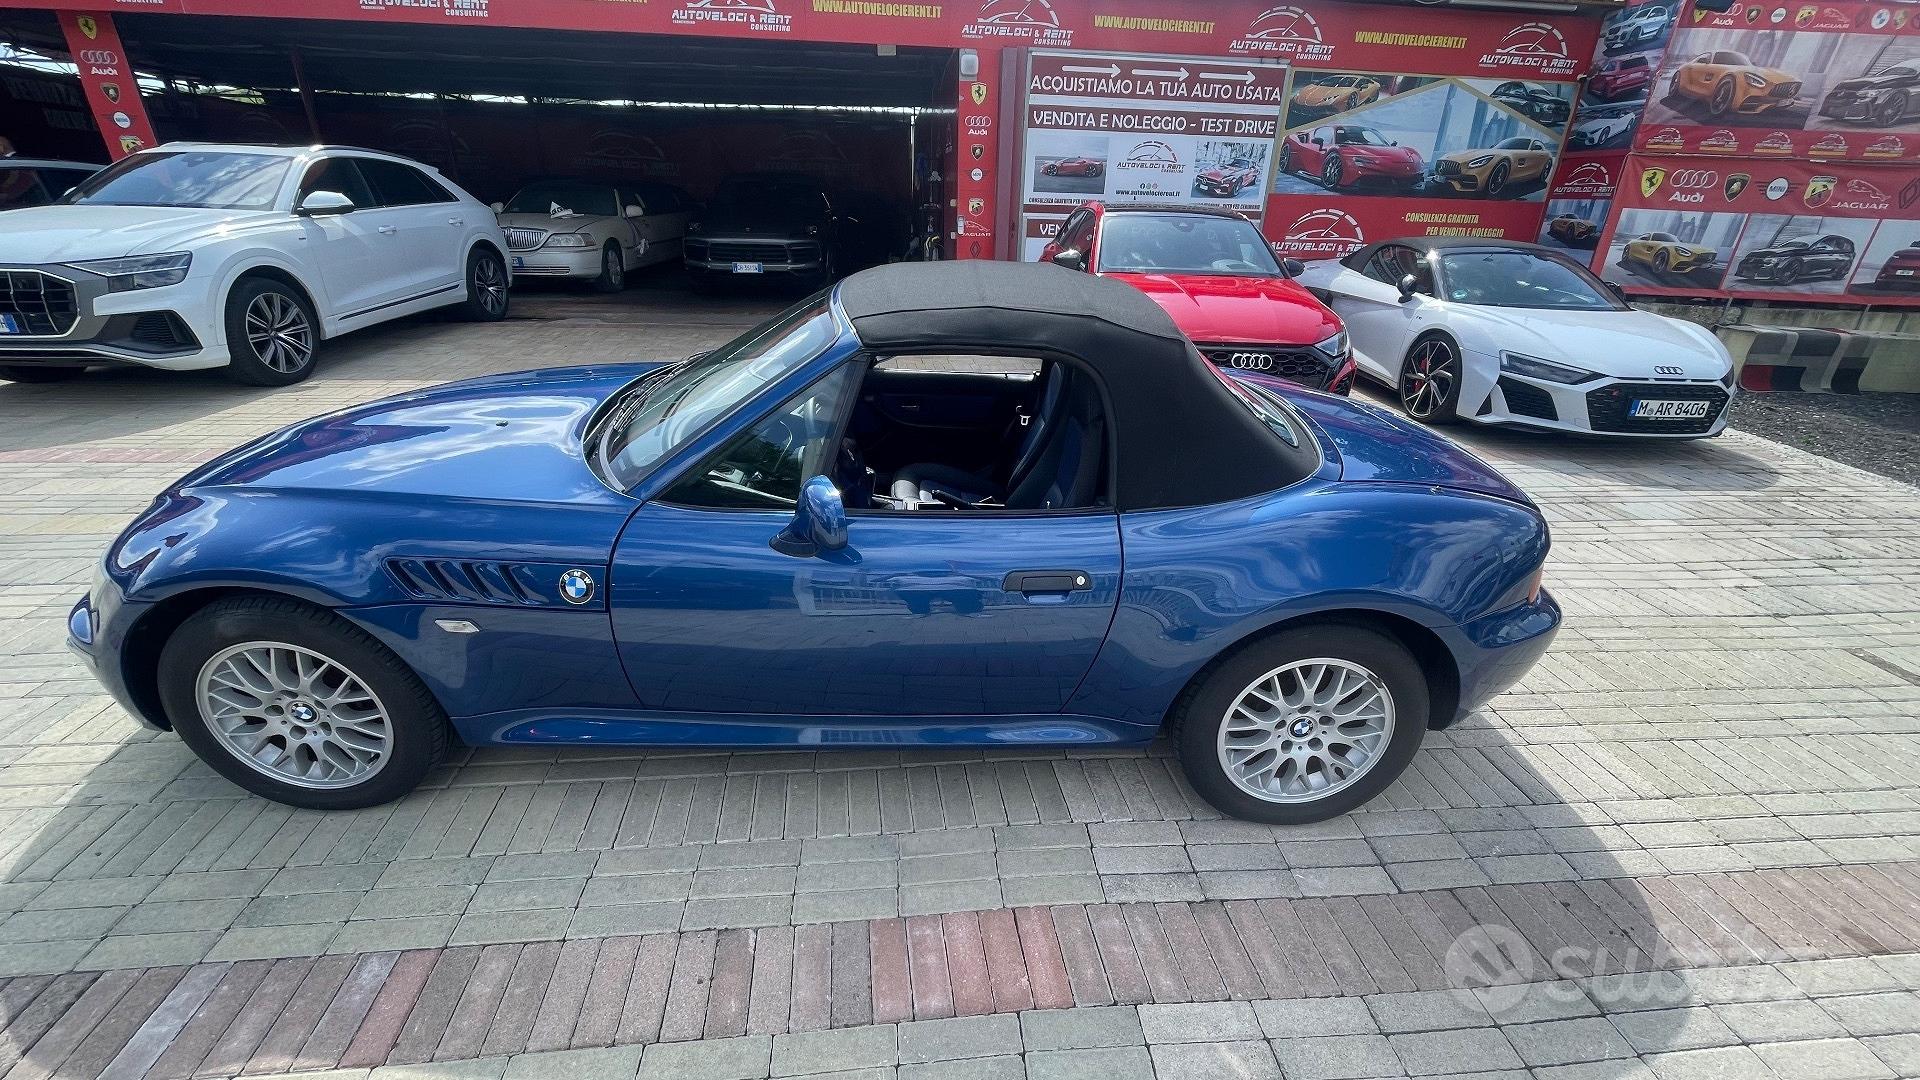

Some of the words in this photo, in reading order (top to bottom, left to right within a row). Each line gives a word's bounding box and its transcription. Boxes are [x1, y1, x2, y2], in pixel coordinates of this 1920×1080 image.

[445, 9, 488, 17] CONSULTING
[812, 0, 942, 18] WWW.AUTOVELOCIERENT.IT
[671, 9, 747, 22] AUTOVELOCI
[749, 15, 756, 23] &
[759, 14, 792, 25] RENT
[1711, 17, 1734, 25] Audi
[750, 23, 791, 32] CONSULTING
[1094, 15, 1215, 34] WWW.AUTOVELOCIERENT.IT
[962, 24, 1032, 36] AUTOVELOCI
[1034, 29, 1040, 37] &
[1043, 28, 1074, 39] RENT
[1033, 38, 1071, 46] CONSULTING
[1229, 39, 1296, 52] AUTOVELOCI
[1297, 44, 1302, 52] &
[1305, 43, 1336, 54] RENT
[1354, 31, 1467, 49] WWW.AUTOVELOCIERENT.IT
[1296, 52, 1332, 60] CONSULTING
[1479, 54, 1542, 66] AUTOVELOCI
[1550, 58, 1577, 68] RENT
[91, 66, 118, 76] Audi
[1031, 75, 1132, 97] ACQUISTIAMO
[1136, 79, 1154, 98] LA
[1160, 80, 1187, 100] TUA
[1192, 82, 1231, 102] AUTO
[1236, 84, 1281, 104] USATA
[1033, 110, 1095, 127] VENDITA
[1101, 112, 1108, 128] E
[1112, 113, 1186, 134] NOLEGGIO
[1200, 117, 1230, 135] TEST
[1235, 119, 1275, 138] DRIVE
[968, 127, 988, 136] Audi
[1668, 191, 1705, 204] Audi
[1832, 202, 1889, 210] JAGUAR
[1405, 212, 1447, 223] CONSULENZA
[1447, 214, 1480, 224] GRATUITA
[1425, 226, 1439, 236] PER
[1439, 227, 1466, 237] VENDITA
[1466, 228, 1471, 236] E
[1471, 228, 1504, 238] NOLEGGIO
[1271, 242, 1336, 251] AUTOVELOCI
[1637, 402, 1649, 415] M
[1655, 403, 1673, 416] AR
[1674, 402, 1706, 416] 8406
[563, 571, 592, 584] BMW
